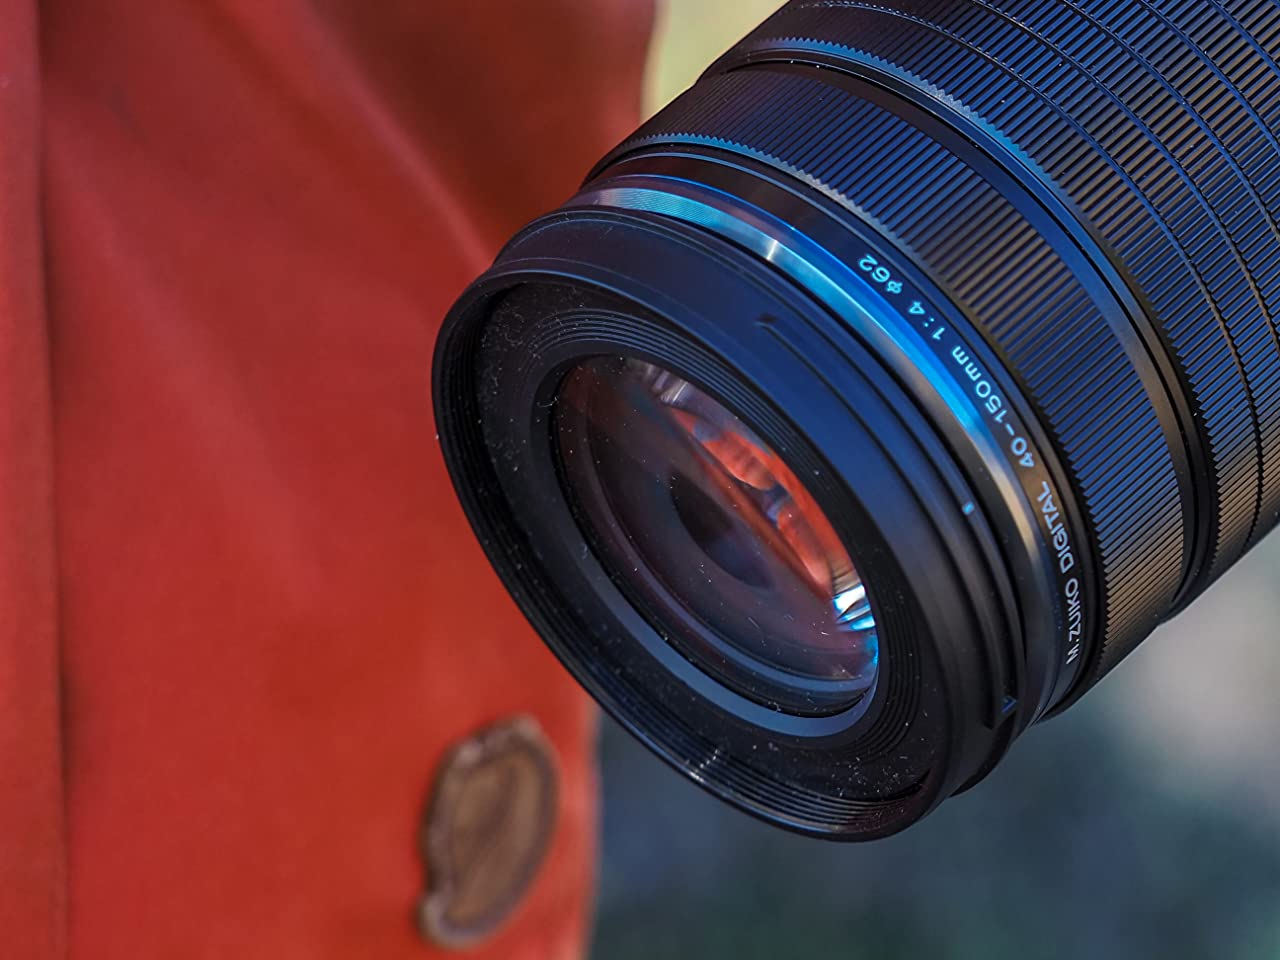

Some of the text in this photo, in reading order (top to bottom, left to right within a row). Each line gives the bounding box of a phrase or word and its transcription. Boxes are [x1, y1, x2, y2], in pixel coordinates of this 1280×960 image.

[951, 346, 1034, 468] 40-150mm
[1037, 481, 1075, 574] DIGITAL
[1066, 578, 1082, 665] M.ZUIKO
